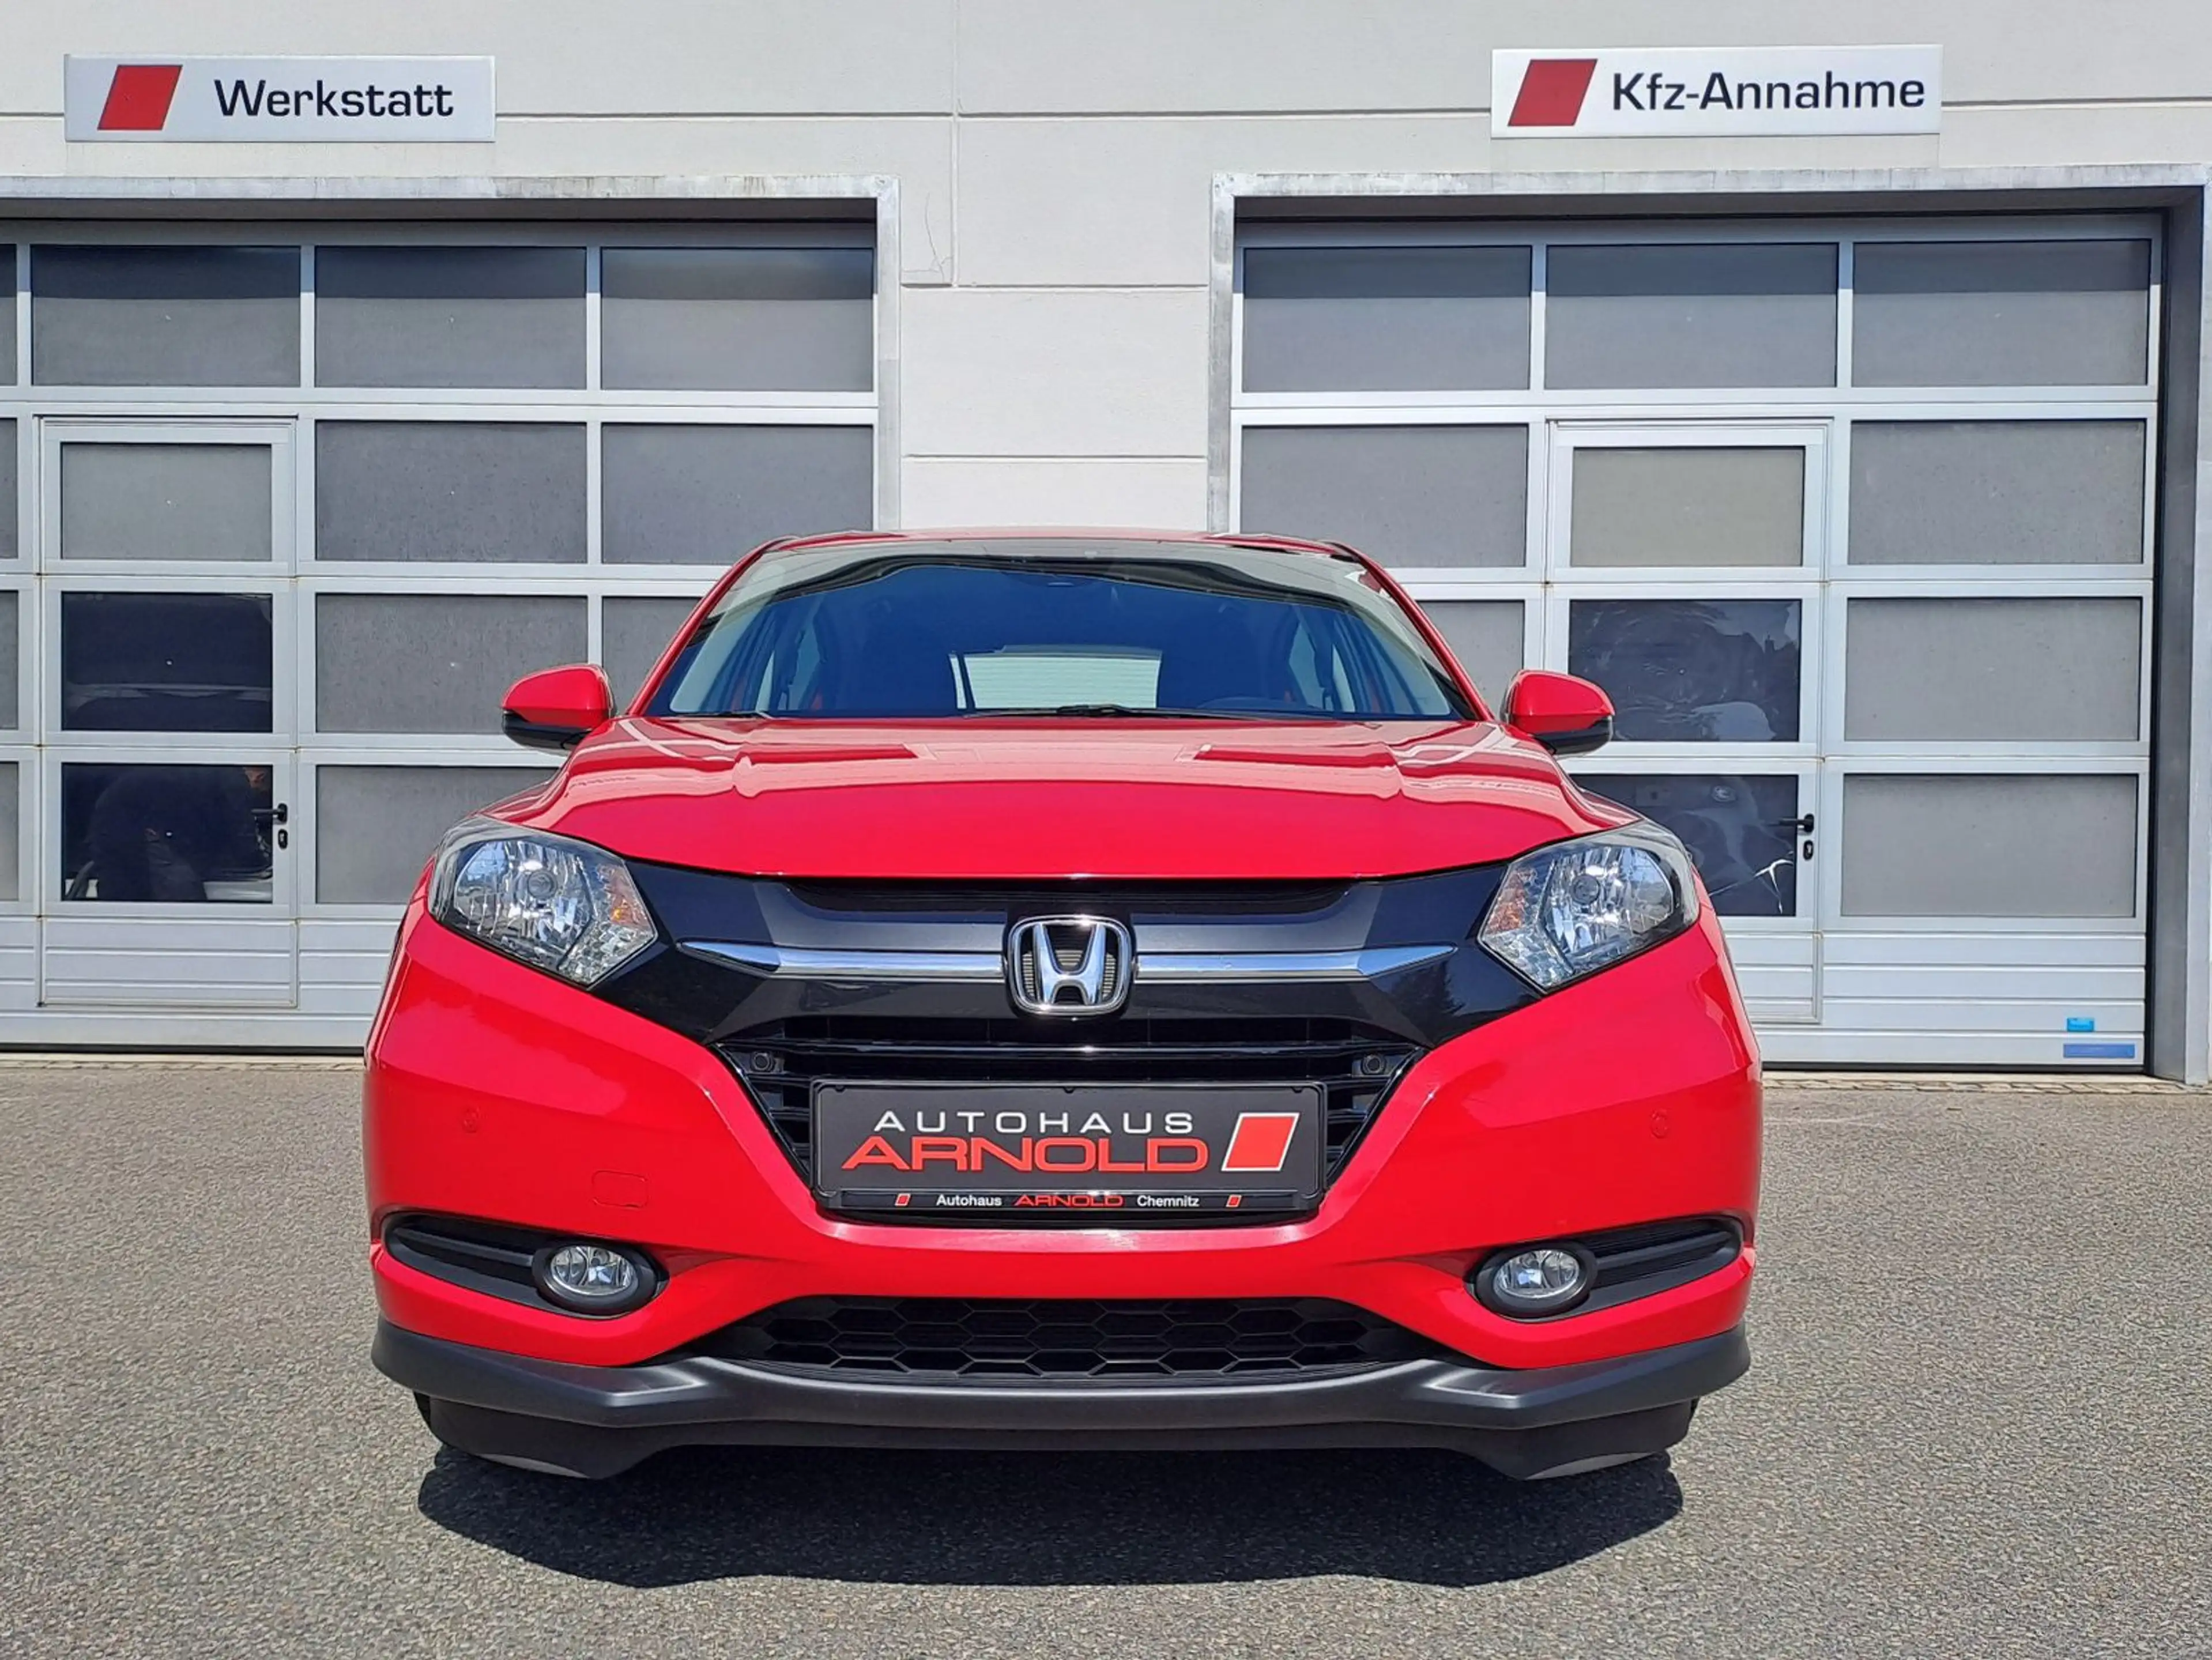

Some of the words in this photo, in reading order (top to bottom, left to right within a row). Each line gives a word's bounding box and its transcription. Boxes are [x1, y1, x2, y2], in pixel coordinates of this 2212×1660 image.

[213, 79, 454, 117] Werkstatt
[1613, 70, 1925, 111] Kfz-Annahme
[873, 1111, 1193, 1134] AUTOHAUS
[841, 1135, 1210, 1174] ARNOLD
[936, 1194, 1003, 1207] Autohaus
[1013, 1194, 1125, 1208] ARNOLD
[1136, 1194, 1200, 1207] Chemnitz
